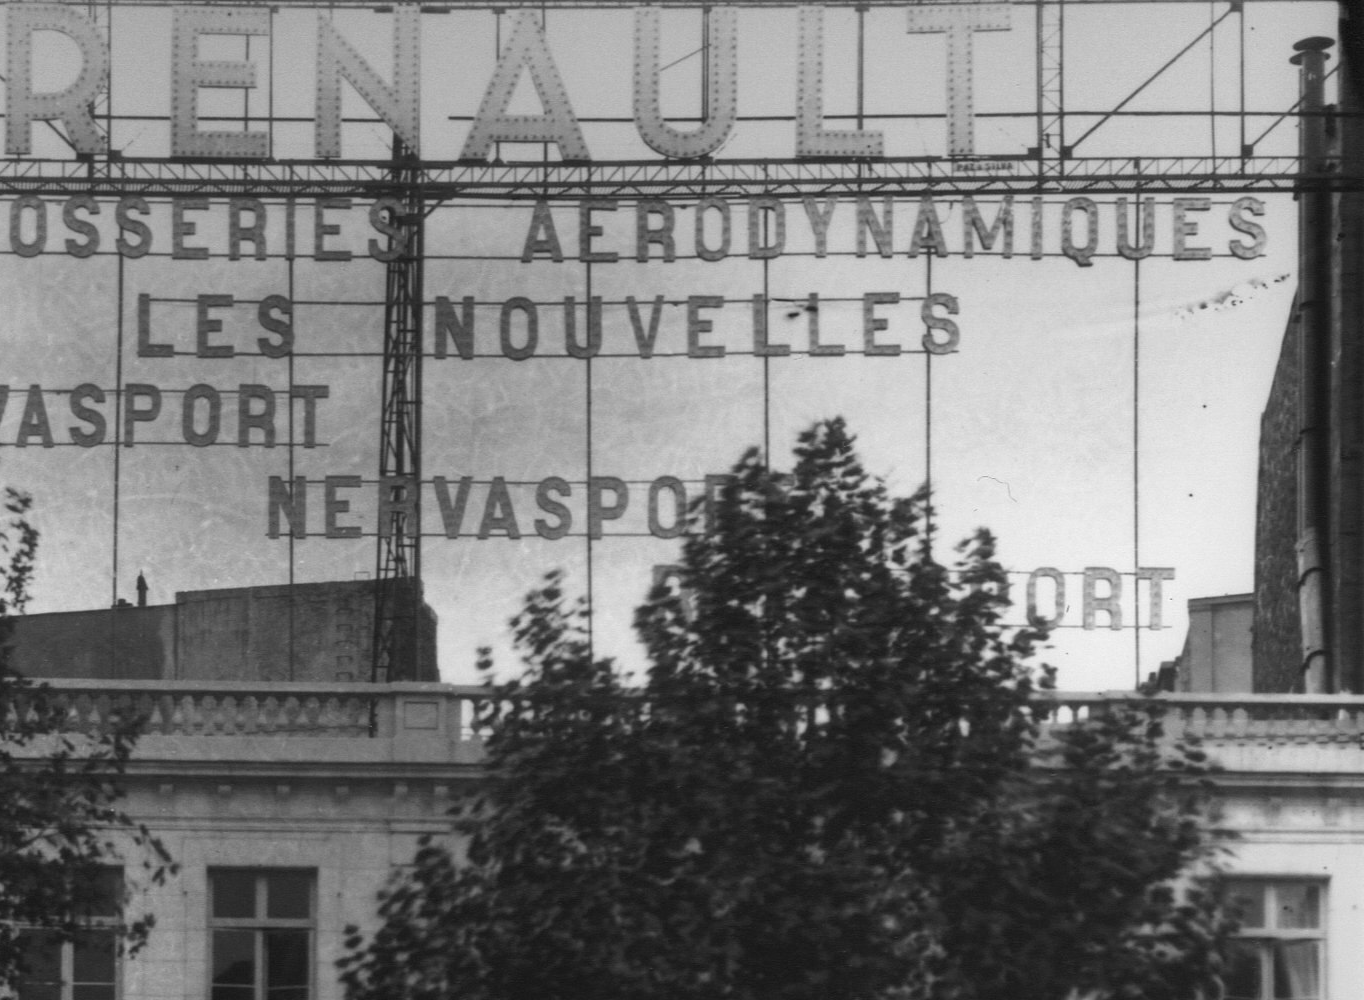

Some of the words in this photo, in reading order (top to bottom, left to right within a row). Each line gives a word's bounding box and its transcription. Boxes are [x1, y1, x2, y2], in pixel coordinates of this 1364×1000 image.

[5, 4, 1012, 160] RENAULT
[520, 193, 1268, 268] AERODYNAMIQUES
[138, 293, 295, 359] LES
[434, 292, 961, 361] NOUVELLES
